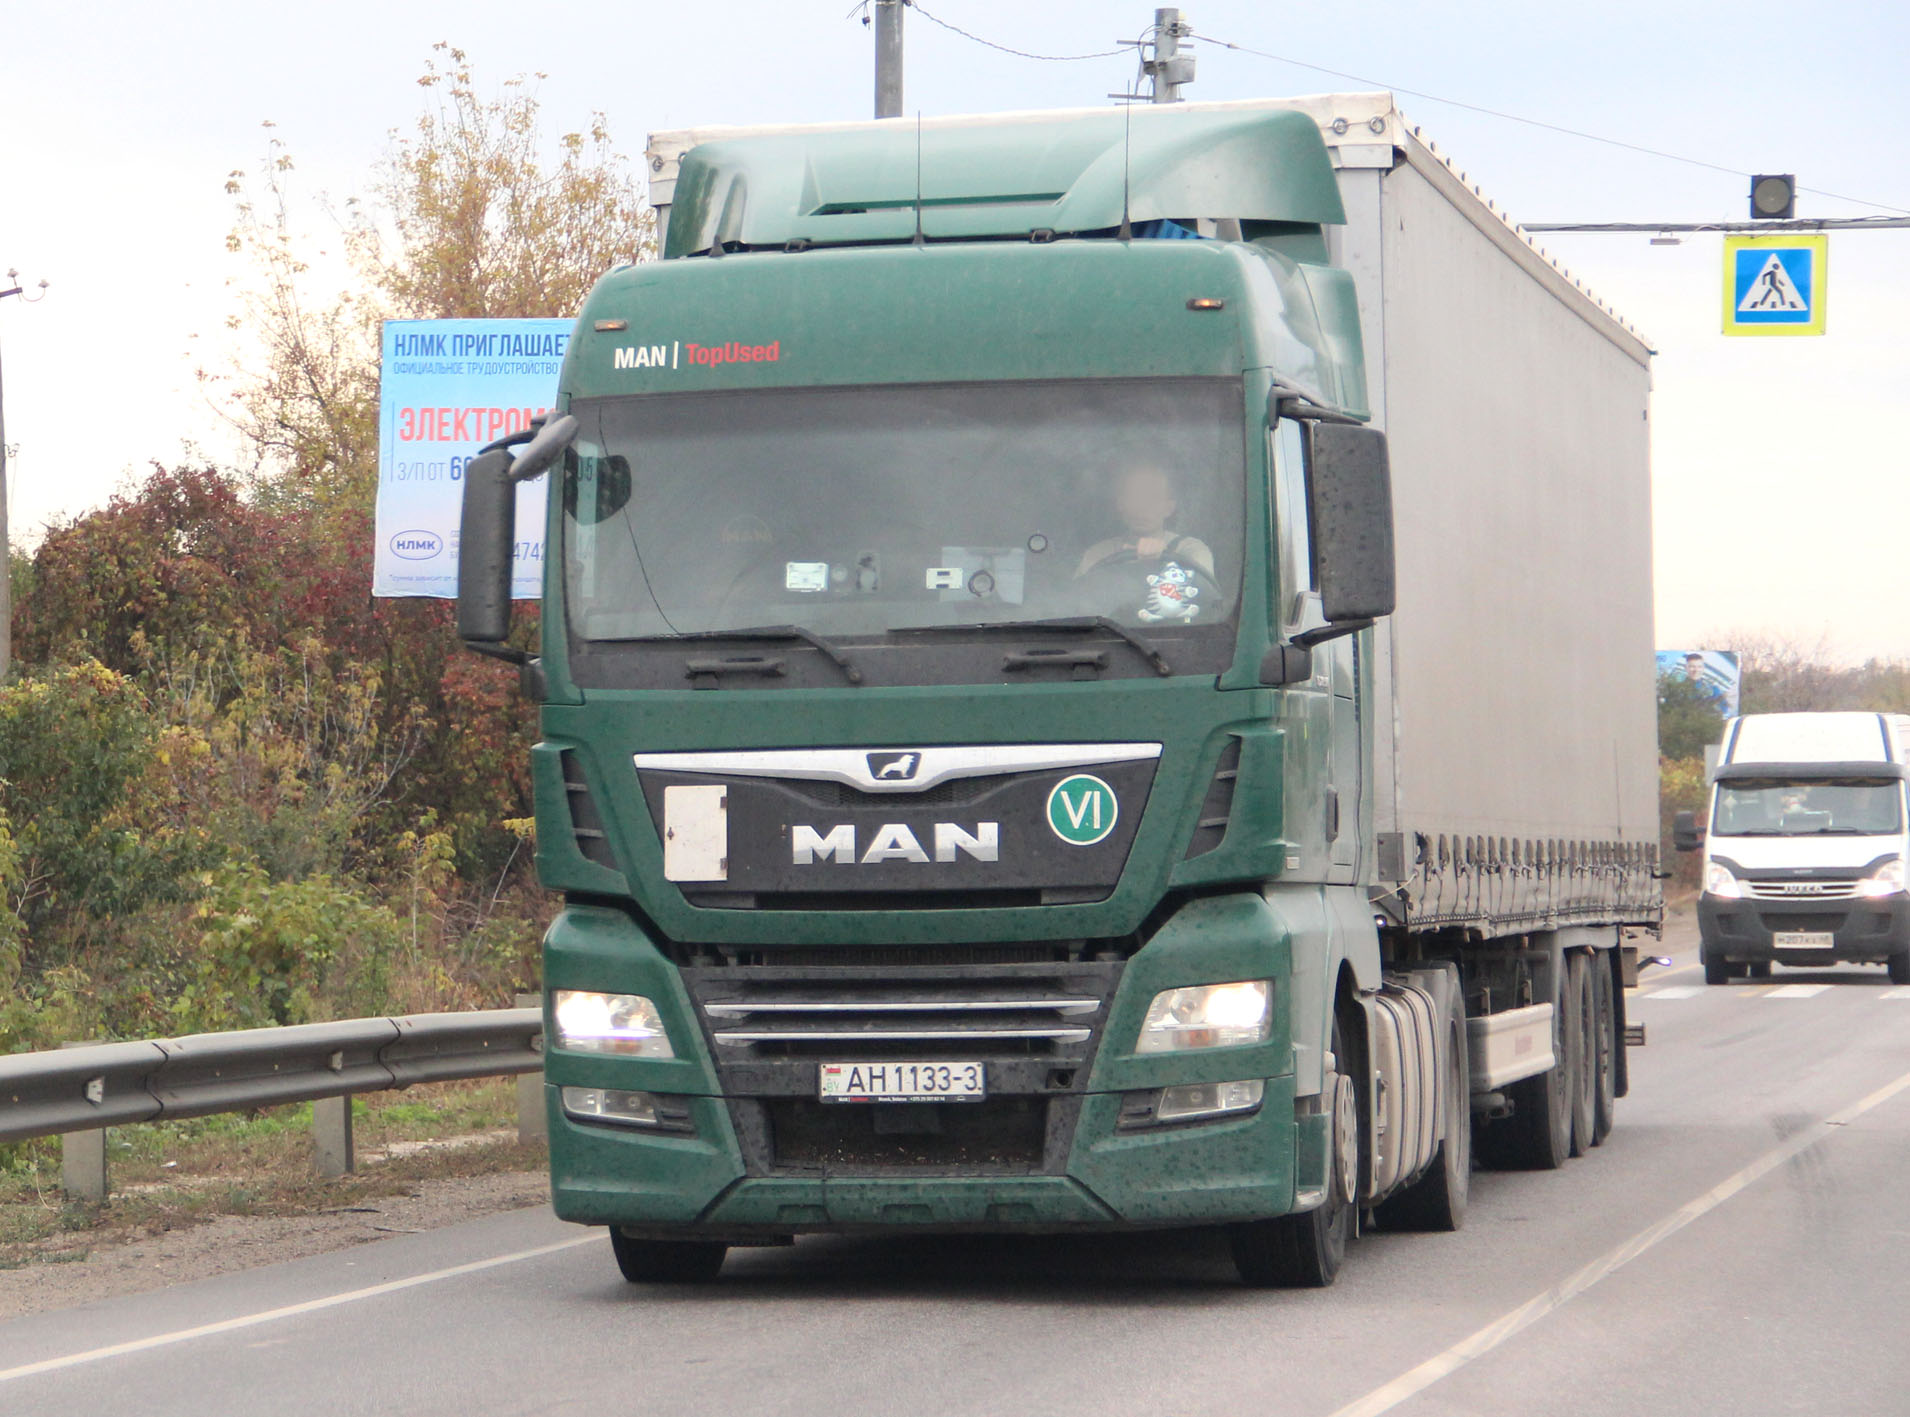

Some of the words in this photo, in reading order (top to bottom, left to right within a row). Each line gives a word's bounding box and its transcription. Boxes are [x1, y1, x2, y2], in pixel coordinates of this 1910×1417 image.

[394, 334, 447, 356] НЛМК
[614, 345, 667, 369] MAN
[685, 340, 780, 368] TopUsed
[393, 361, 464, 375] ОФИЦИАЛЬНОЕ
[466, 360, 559, 376] ТРУДОУСТРОЙСТВО
[396, 539, 436, 551] НЛМК
[1060, 791, 1101, 830] VI
[792, 822, 999, 865] MAN
